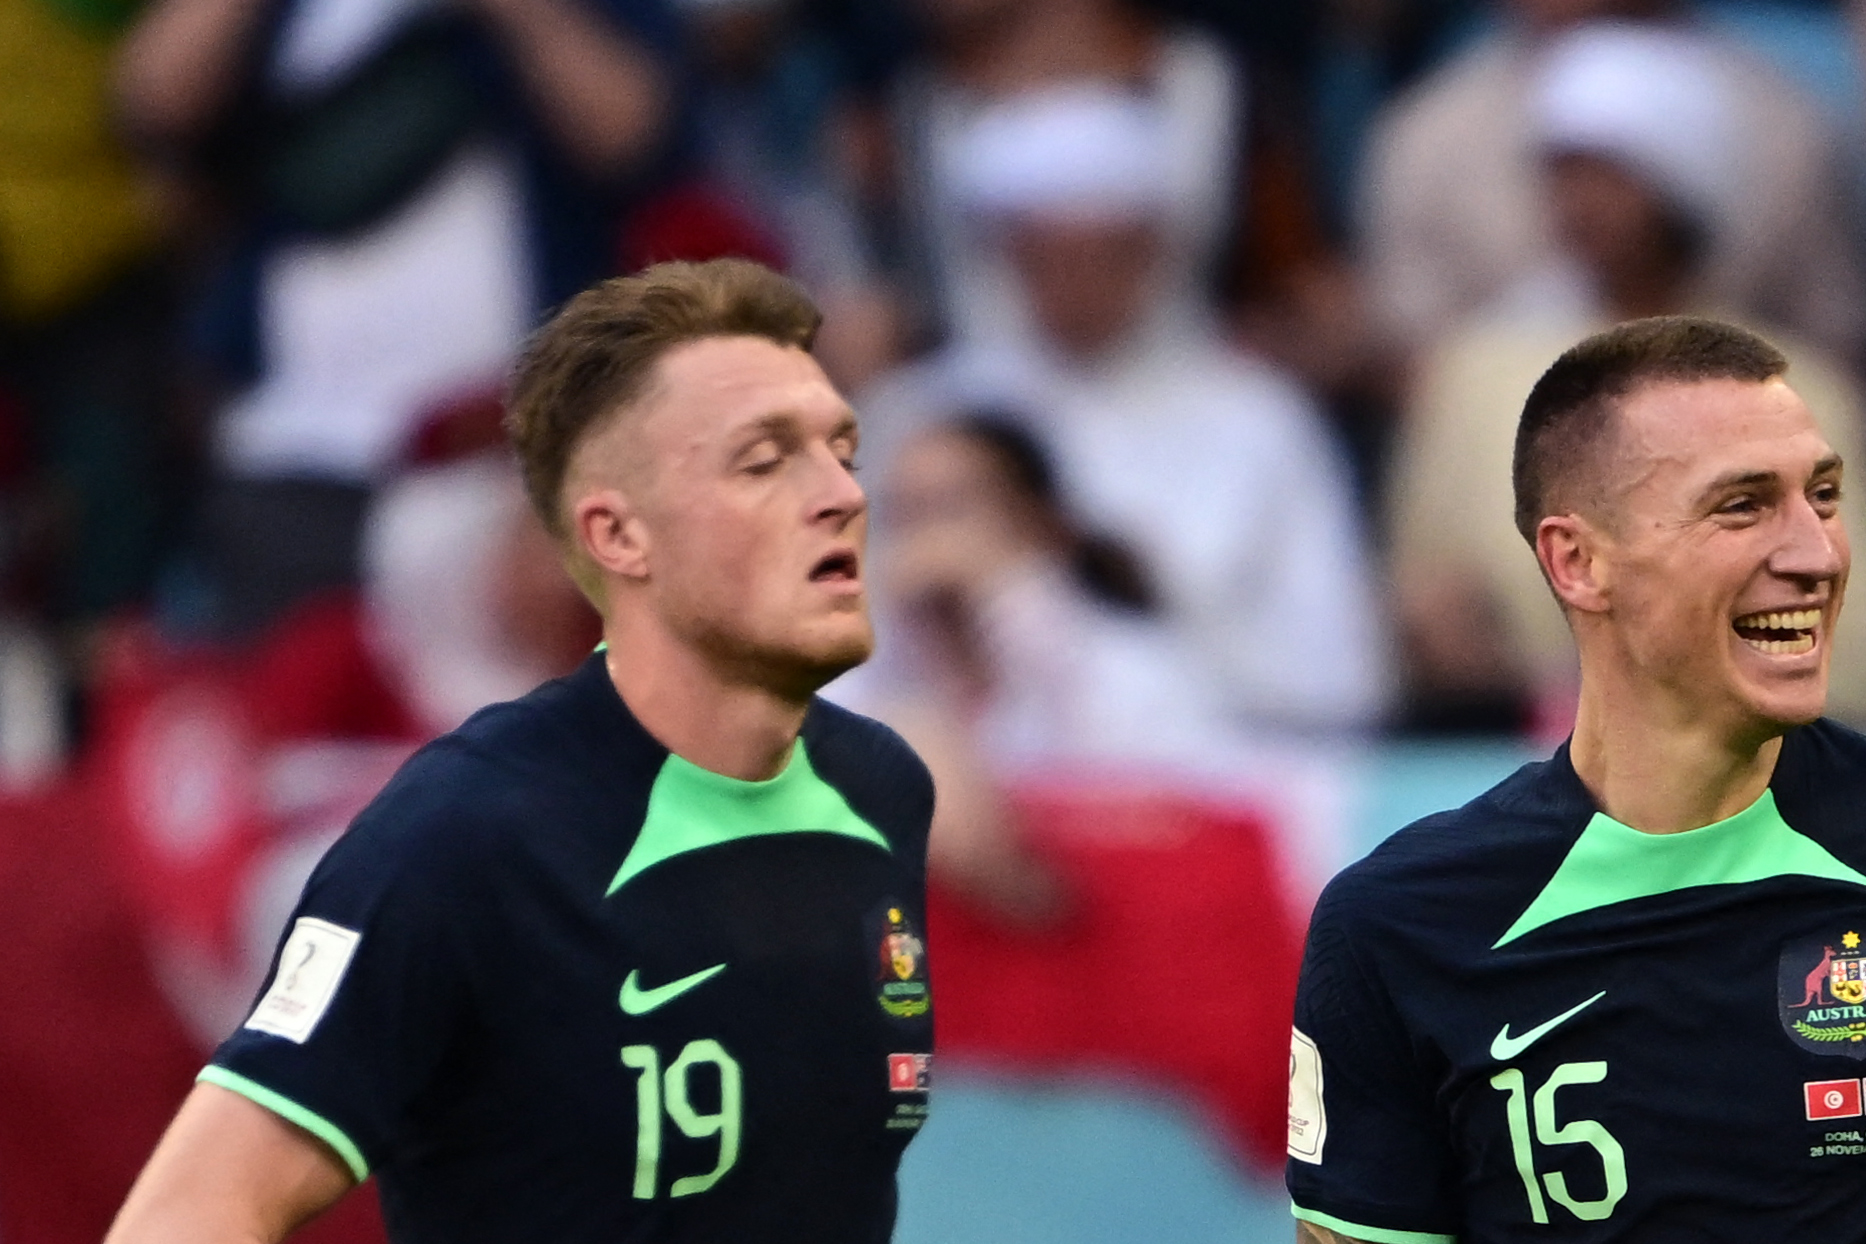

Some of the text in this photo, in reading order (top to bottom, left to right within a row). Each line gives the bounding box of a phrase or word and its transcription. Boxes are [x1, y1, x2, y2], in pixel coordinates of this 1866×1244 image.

[620, 1038, 742, 1200] 19
[1489, 1060, 1628, 1224] 15
[1825, 1131, 1864, 1142] DOHA,
